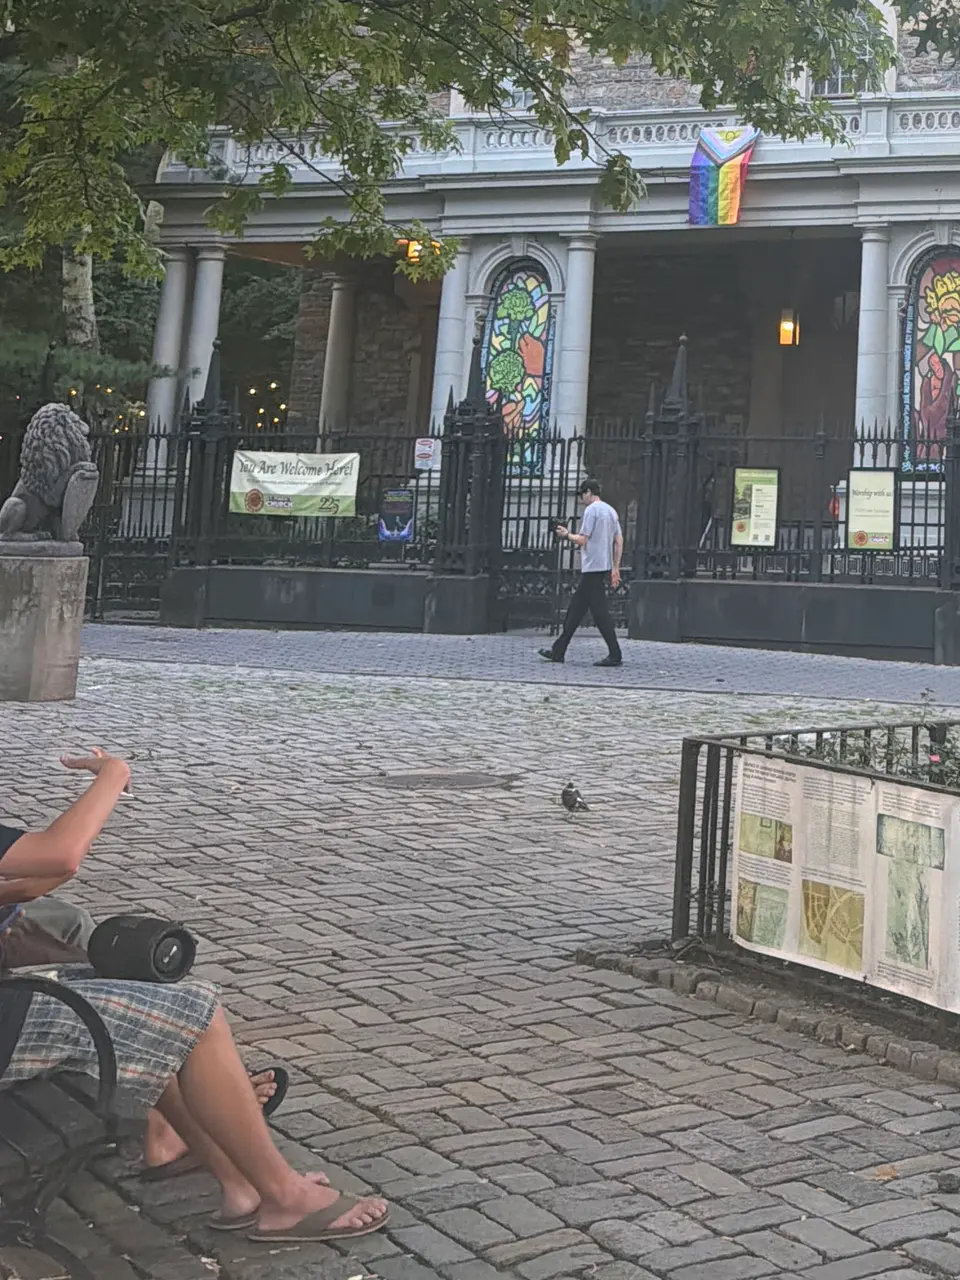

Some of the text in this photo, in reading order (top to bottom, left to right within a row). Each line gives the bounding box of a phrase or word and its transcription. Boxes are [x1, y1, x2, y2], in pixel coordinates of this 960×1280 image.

[239, 460, 354, 476] You Are Welcome Here!
